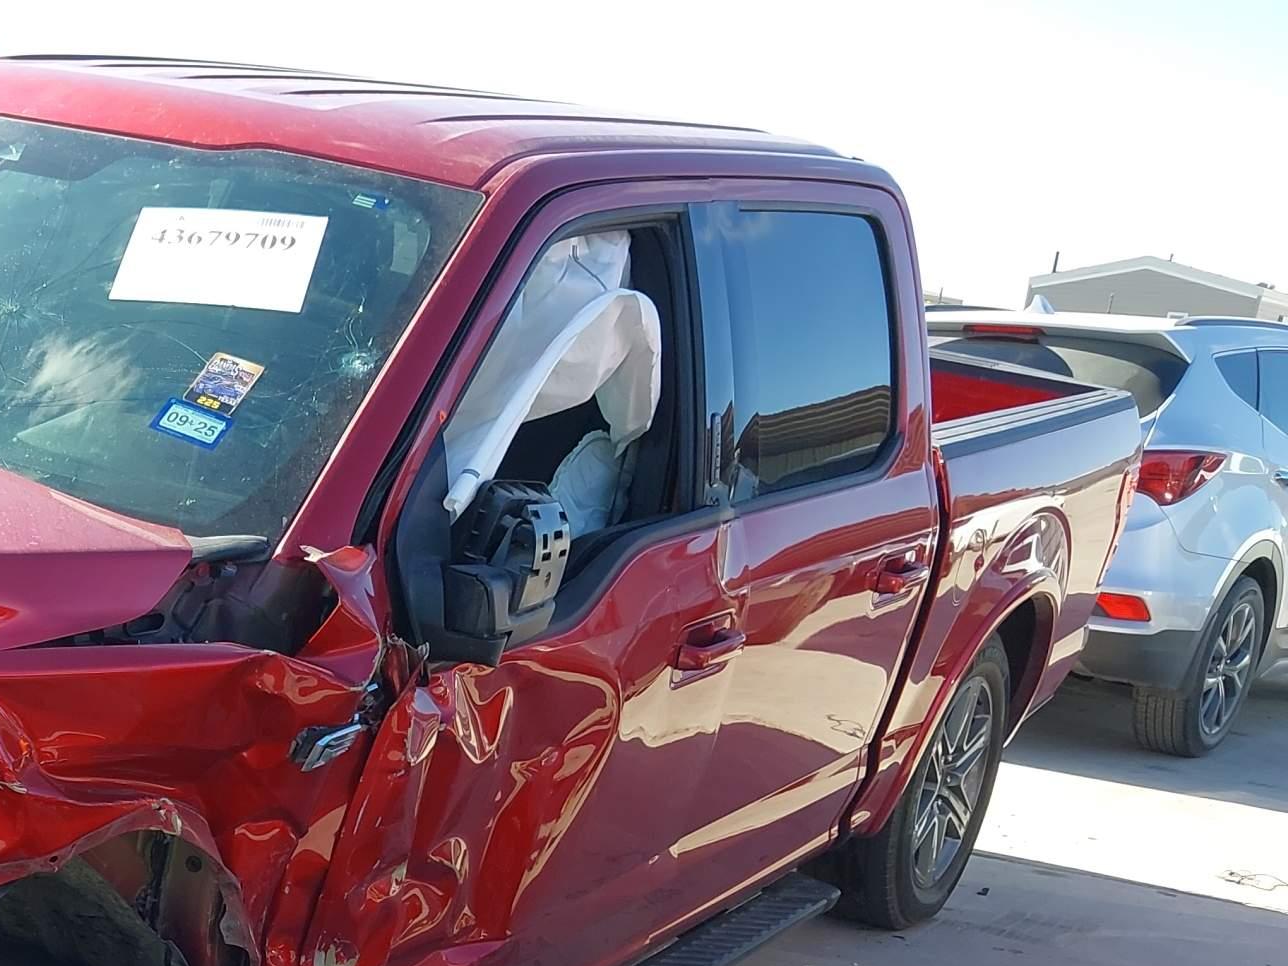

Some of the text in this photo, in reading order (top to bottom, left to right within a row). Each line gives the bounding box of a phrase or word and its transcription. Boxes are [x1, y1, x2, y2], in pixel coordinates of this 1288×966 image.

[151, 228, 297, 251] 43679709
[166, 411, 218, 438] 09 25
